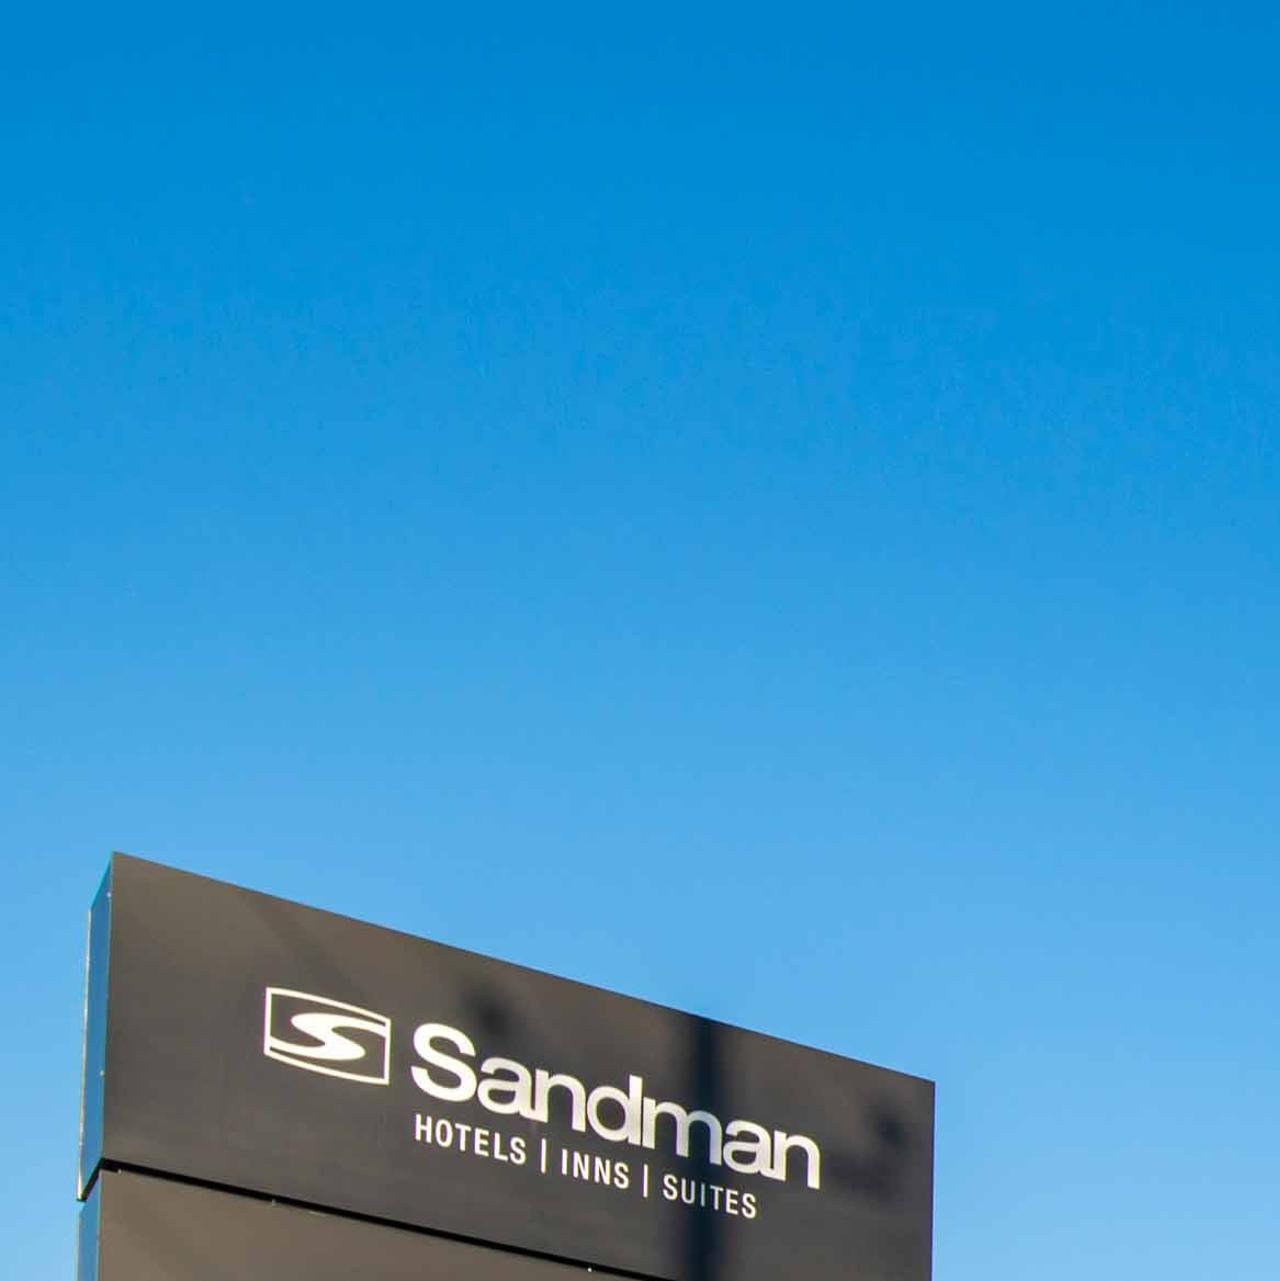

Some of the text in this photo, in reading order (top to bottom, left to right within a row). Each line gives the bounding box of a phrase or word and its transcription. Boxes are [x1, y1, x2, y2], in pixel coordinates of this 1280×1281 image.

[410, 1023, 821, 1190] Sandman
[414, 1113, 527, 1166] HOTELS
[562, 1148, 630, 1190] INNS
[662, 1173, 758, 1221] SUITES
